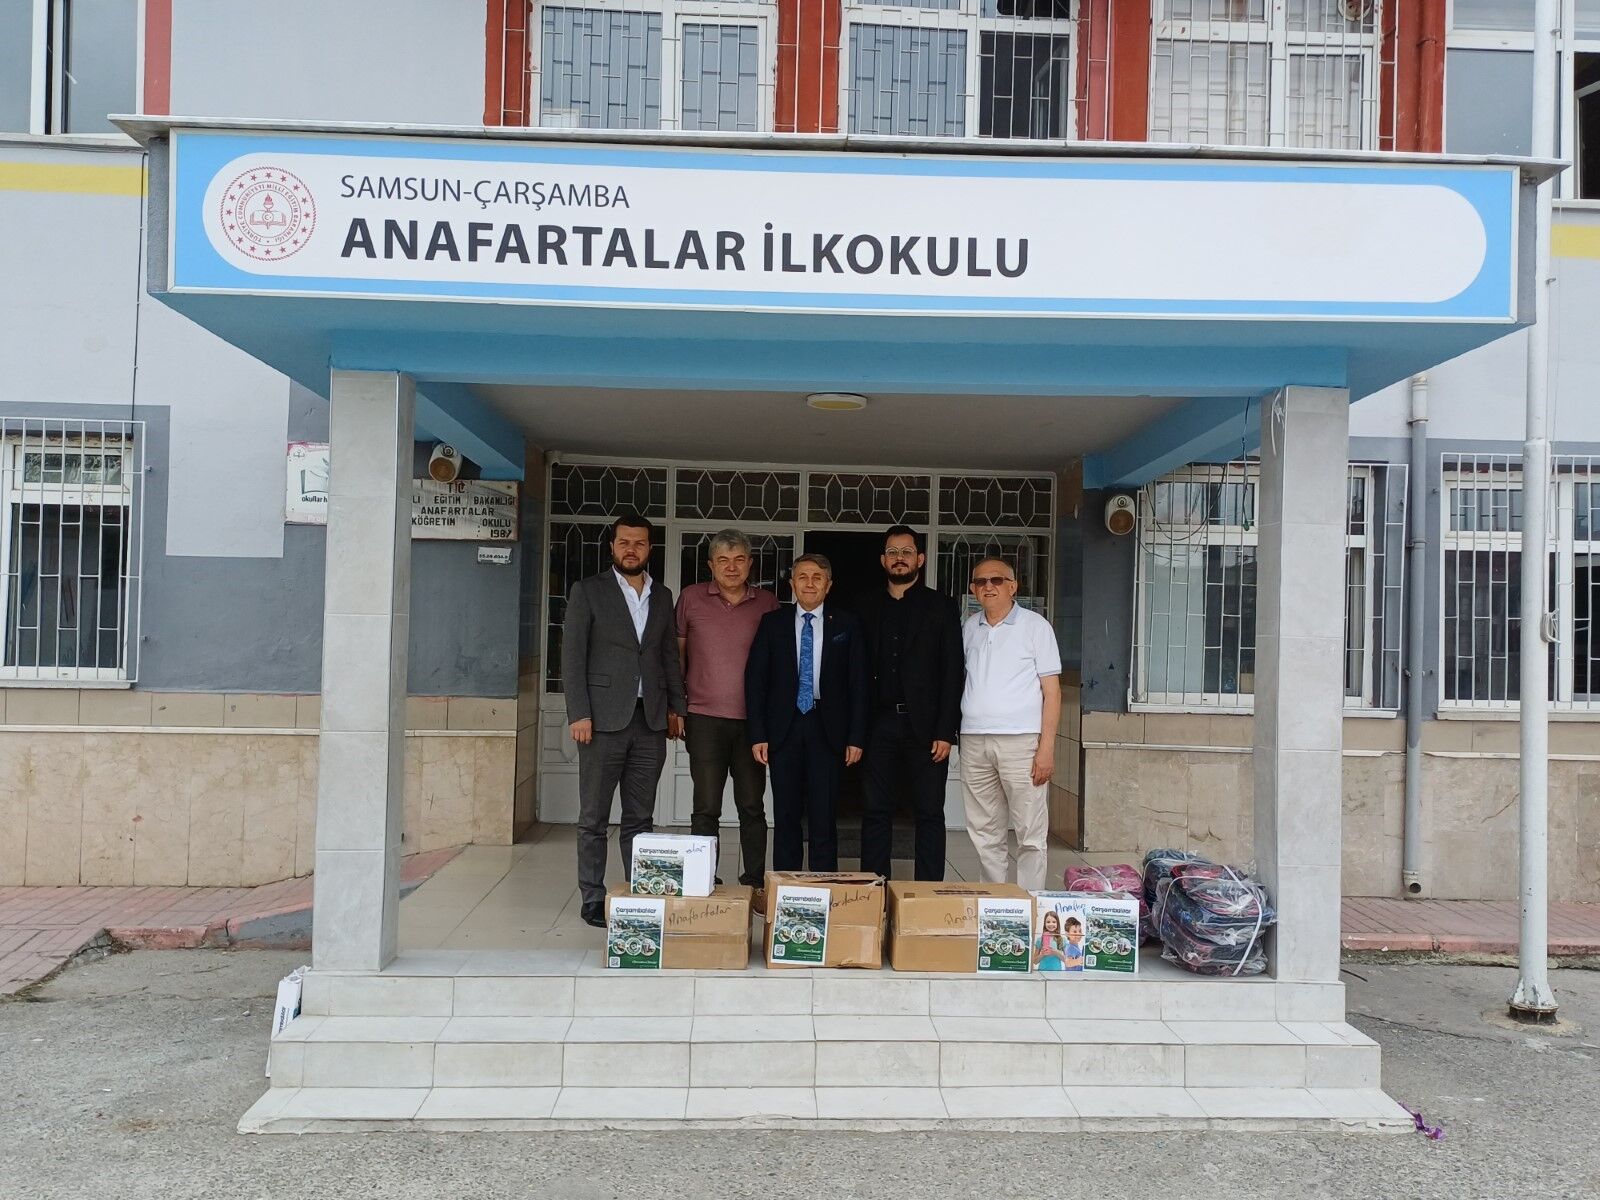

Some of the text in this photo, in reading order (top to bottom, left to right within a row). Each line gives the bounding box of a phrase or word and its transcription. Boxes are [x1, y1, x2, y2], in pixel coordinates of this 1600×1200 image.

[340, 174, 631, 211] SAMSUN-ÇARŞAMBA
[340, 217, 1029, 278] ANAFARTALAR İLKOKULU
[302, 495, 323, 503] okullar
[421, 506, 495, 516] ANAFARTALAR
[411, 515, 512, 528] KÖĞRETİM OKULU
[490, 529, 512, 538] 1987
